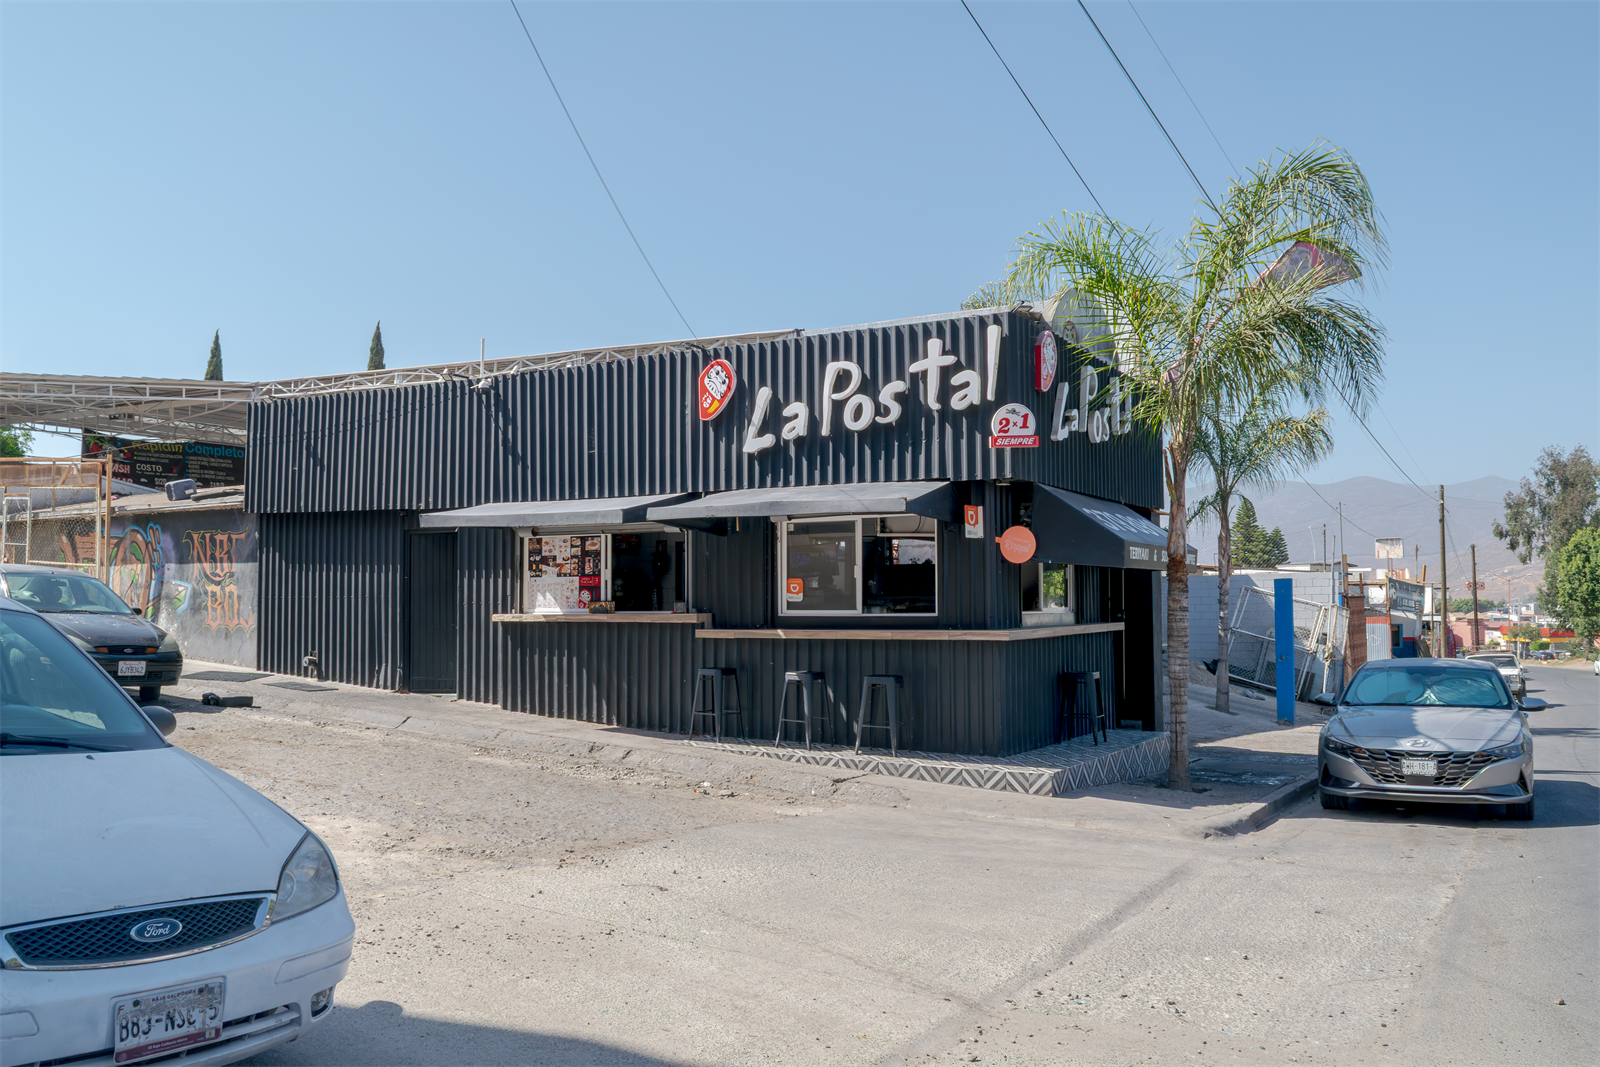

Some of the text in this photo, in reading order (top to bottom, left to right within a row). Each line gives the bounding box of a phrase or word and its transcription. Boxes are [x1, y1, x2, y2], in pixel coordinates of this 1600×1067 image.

[742, 325, 1001, 453] La Postal
[1051, 381, 1079, 441] La
[995, 437, 1035, 446] SIEMPRE
[185, 442, 244, 458] Completo
[136, 463, 162, 472] COSTO
[1004, 539, 1032, 554] Rappi
[1129, 546, 1149, 560] TERIYAKI
[145, 922, 171, 937] Ford
